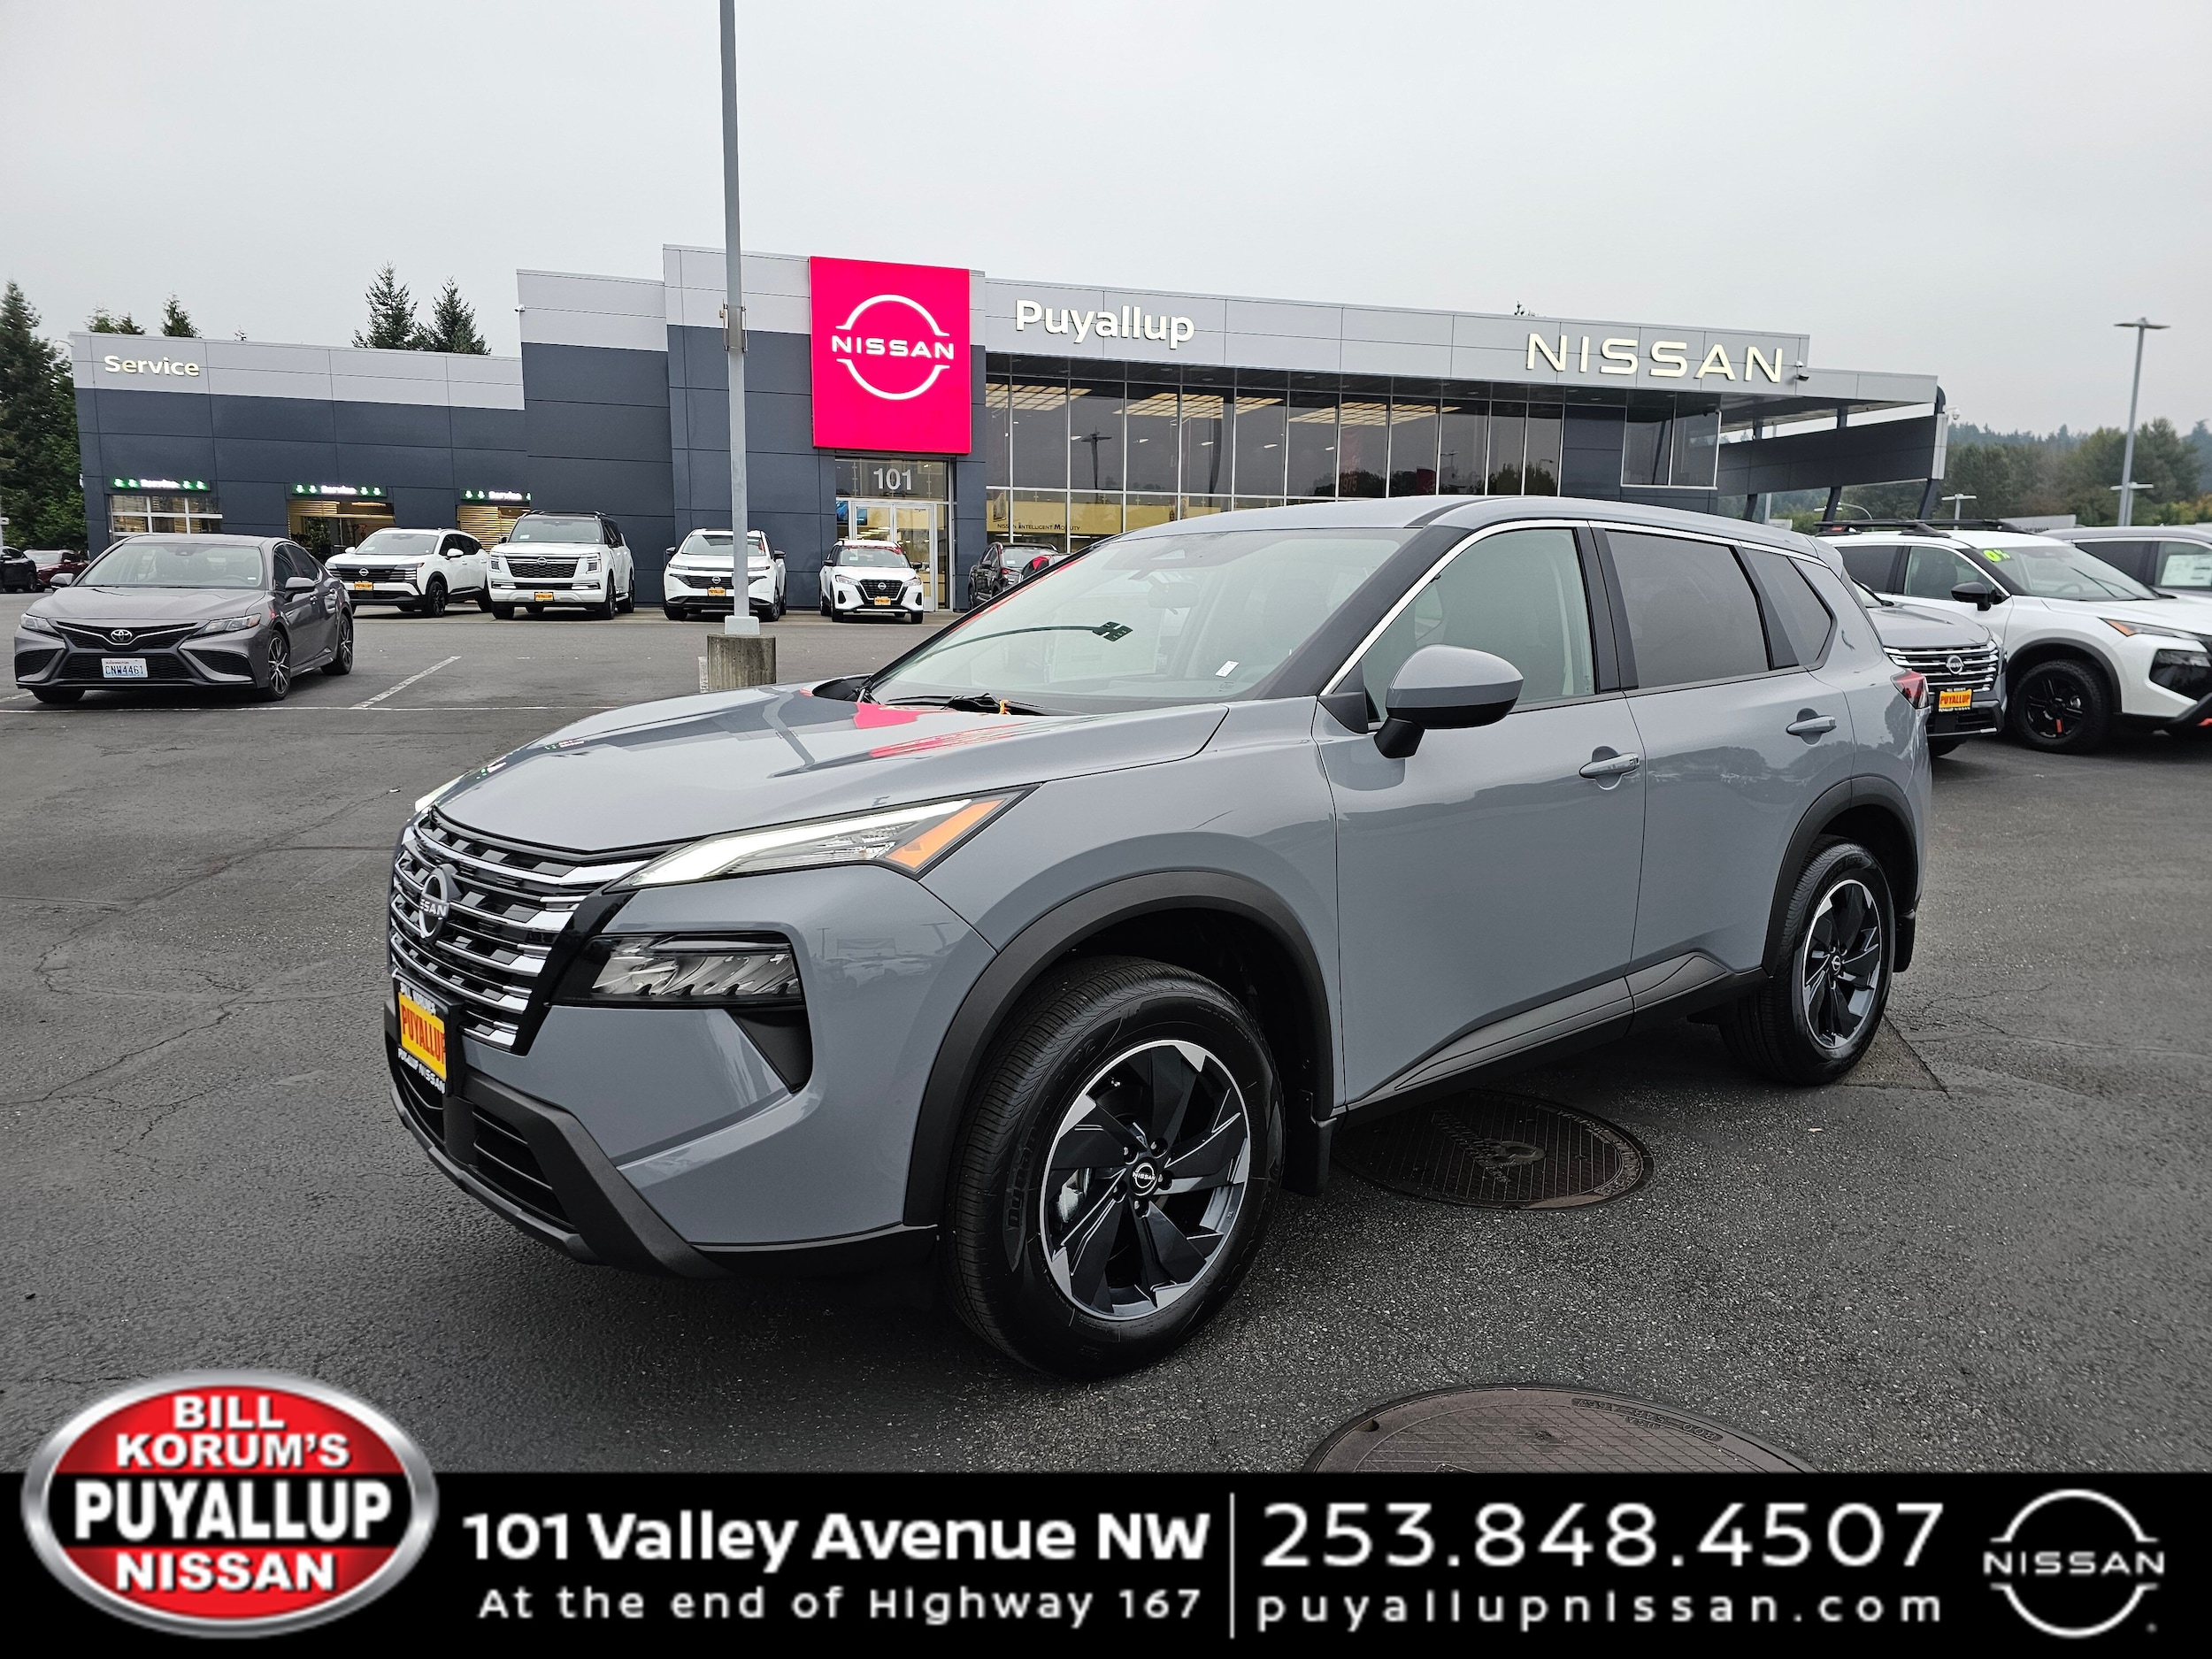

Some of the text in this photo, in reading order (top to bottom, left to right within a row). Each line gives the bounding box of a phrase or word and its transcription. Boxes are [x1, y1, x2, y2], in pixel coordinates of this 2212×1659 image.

[1016, 299, 1194, 349] Puyallup
[832, 335, 955, 359] NISSAN
[1526, 333, 1783, 383] NISSAN
[104, 355, 200, 377] Service
[873, 468, 911, 490] 101
[420, 898, 448, 917] SSAN
